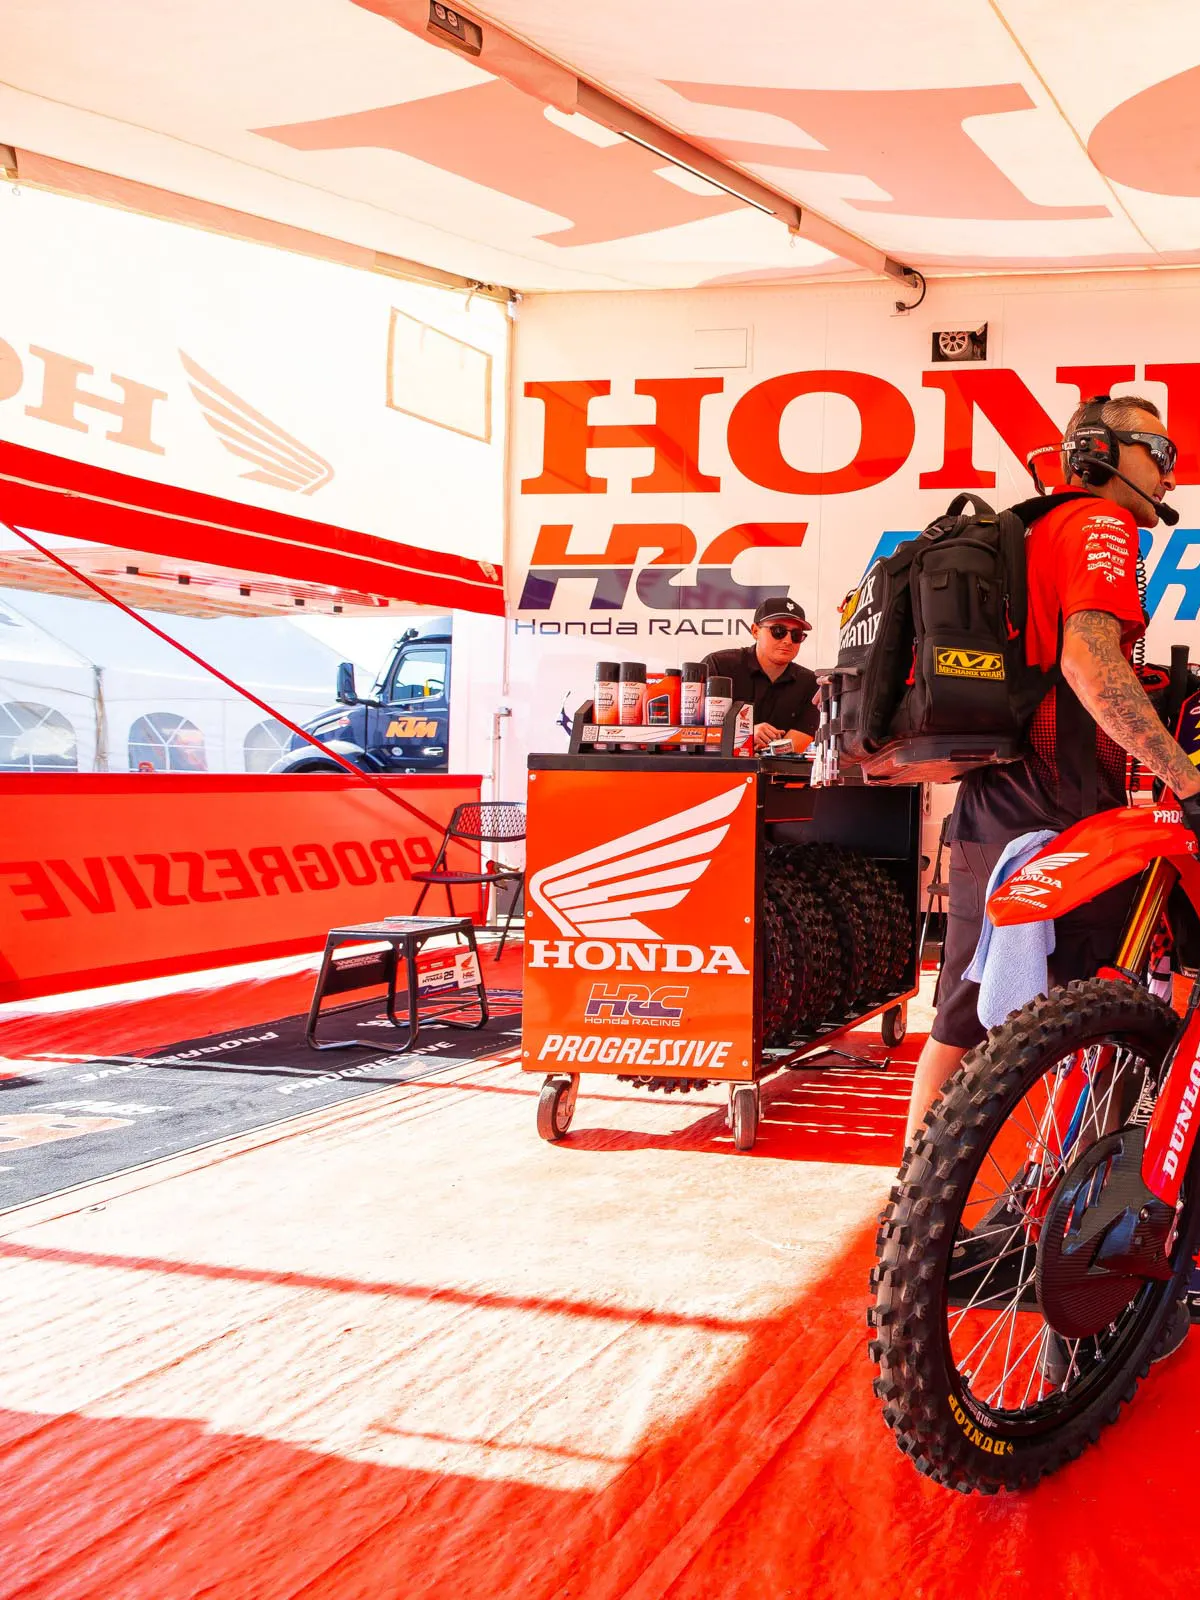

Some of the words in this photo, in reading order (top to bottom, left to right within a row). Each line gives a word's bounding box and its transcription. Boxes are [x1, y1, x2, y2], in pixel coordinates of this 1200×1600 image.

[518, 522, 809, 610] HRC
[514, 617, 638, 636] Honda
[648, 618, 753, 636] RACIN
[938, 664, 979, 676] MECHANIX
[980, 671, 1003, 679] WEAR
[385, 716, 439, 738] KTM
[1010, 872, 1063, 890] HONDA
[528, 939, 750, 975] HONDA
[584, 983, 689, 1017] HRC
[584, 1016, 629, 1026] Honda
[631, 1016, 681, 1027] RACING
[537, 1034, 733, 1068] PROGRESSIVE
[947, 1394, 1007, 1456] DUNLOP
